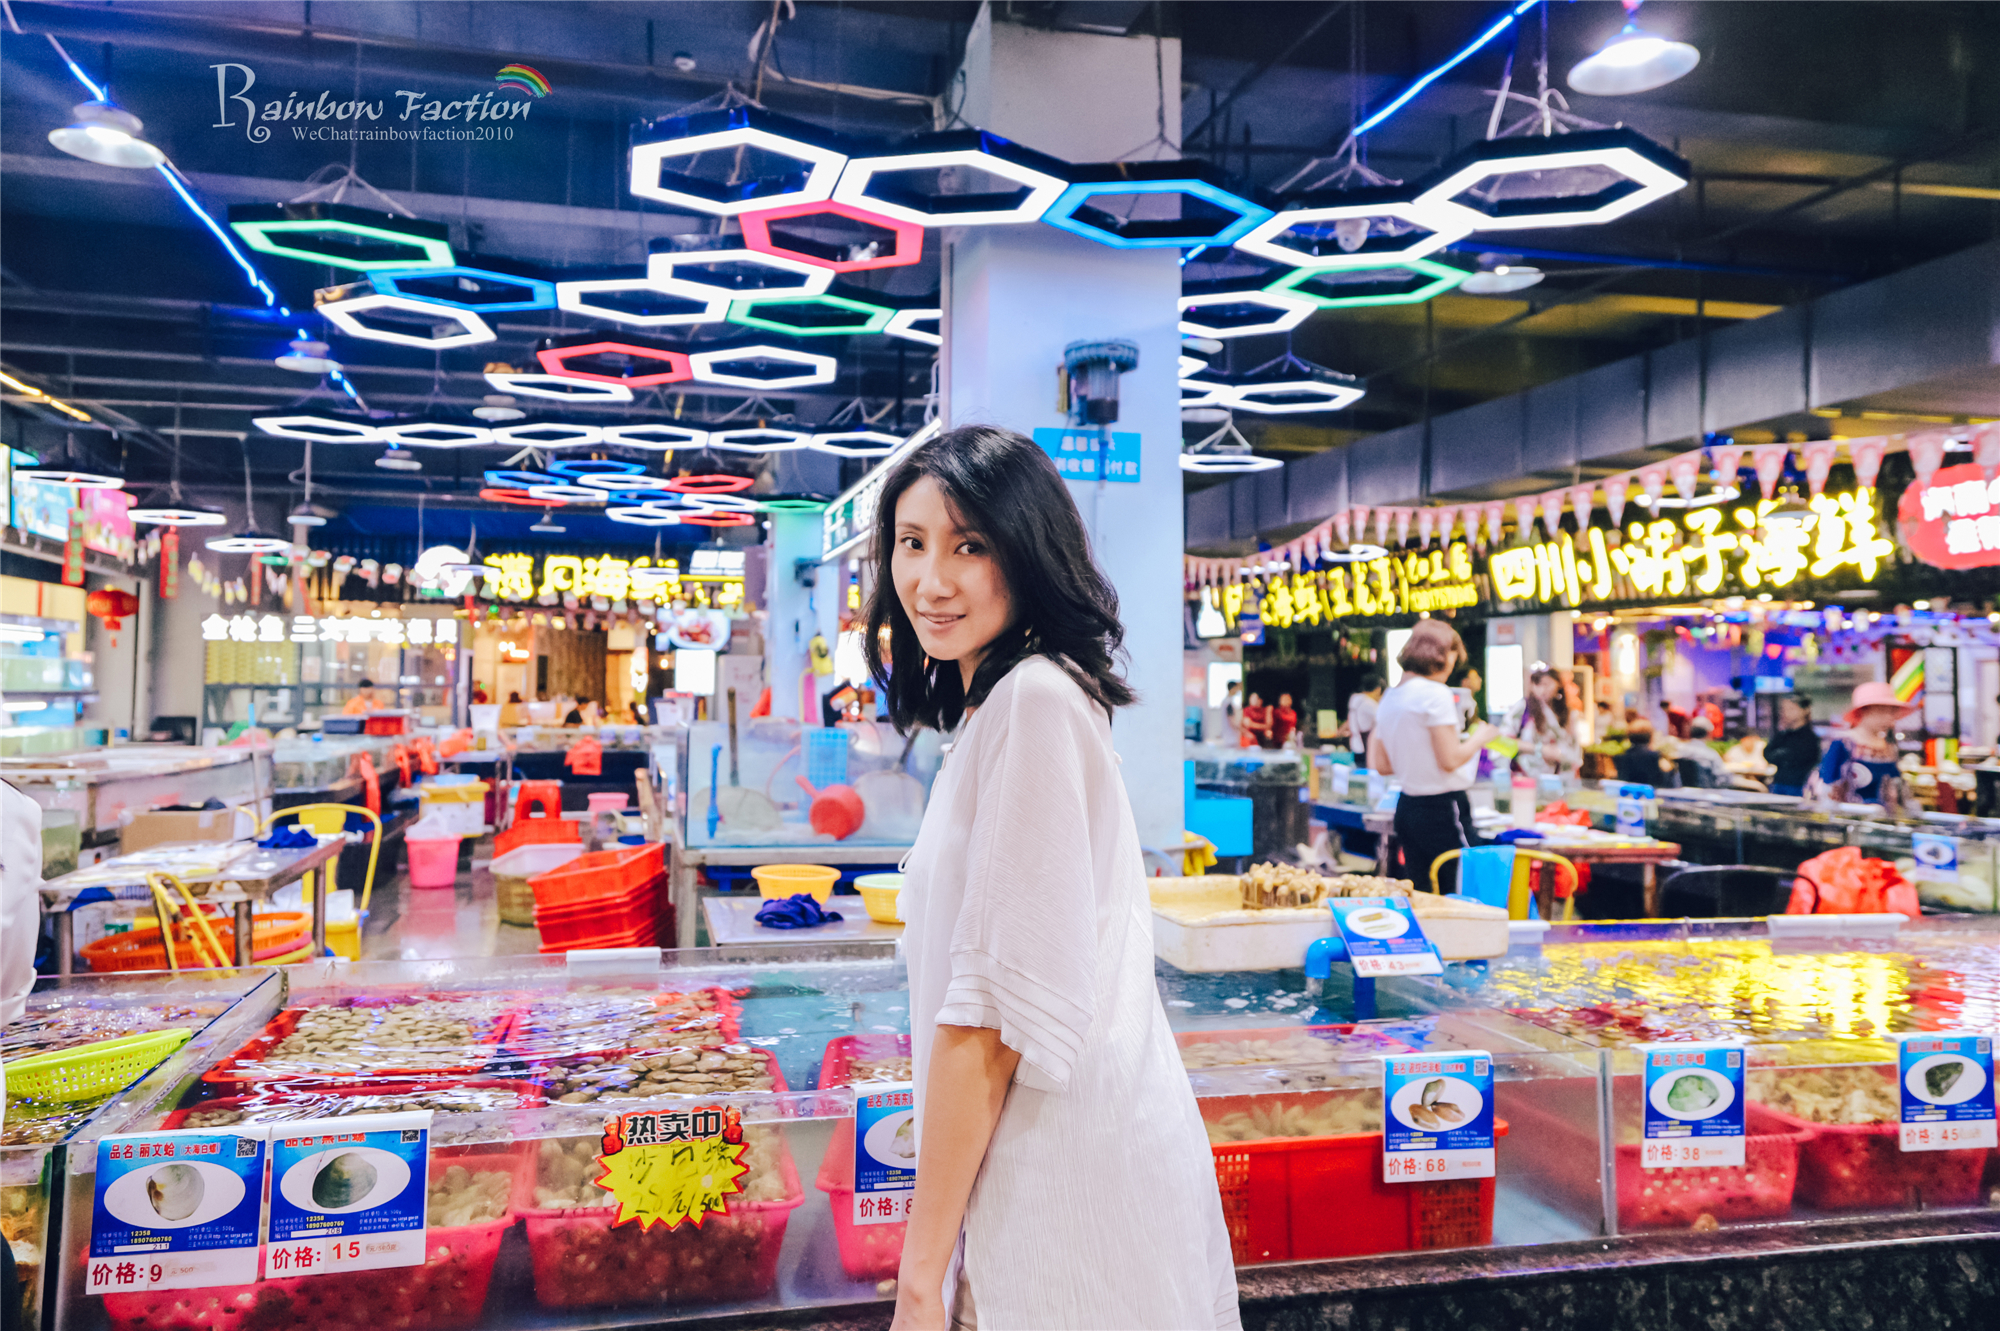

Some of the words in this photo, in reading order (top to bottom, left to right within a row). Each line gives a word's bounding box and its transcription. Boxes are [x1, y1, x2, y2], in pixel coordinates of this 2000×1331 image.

[627, 1110, 722, 1145] 热卖中
[1941, 1128, 1959, 1141] 45
[1682, 1147, 1700, 1161] 38
[1426, 1158, 1445, 1172] 68
[332, 1241, 361, 1260] 15
[150, 1264, 163, 1282] 9
